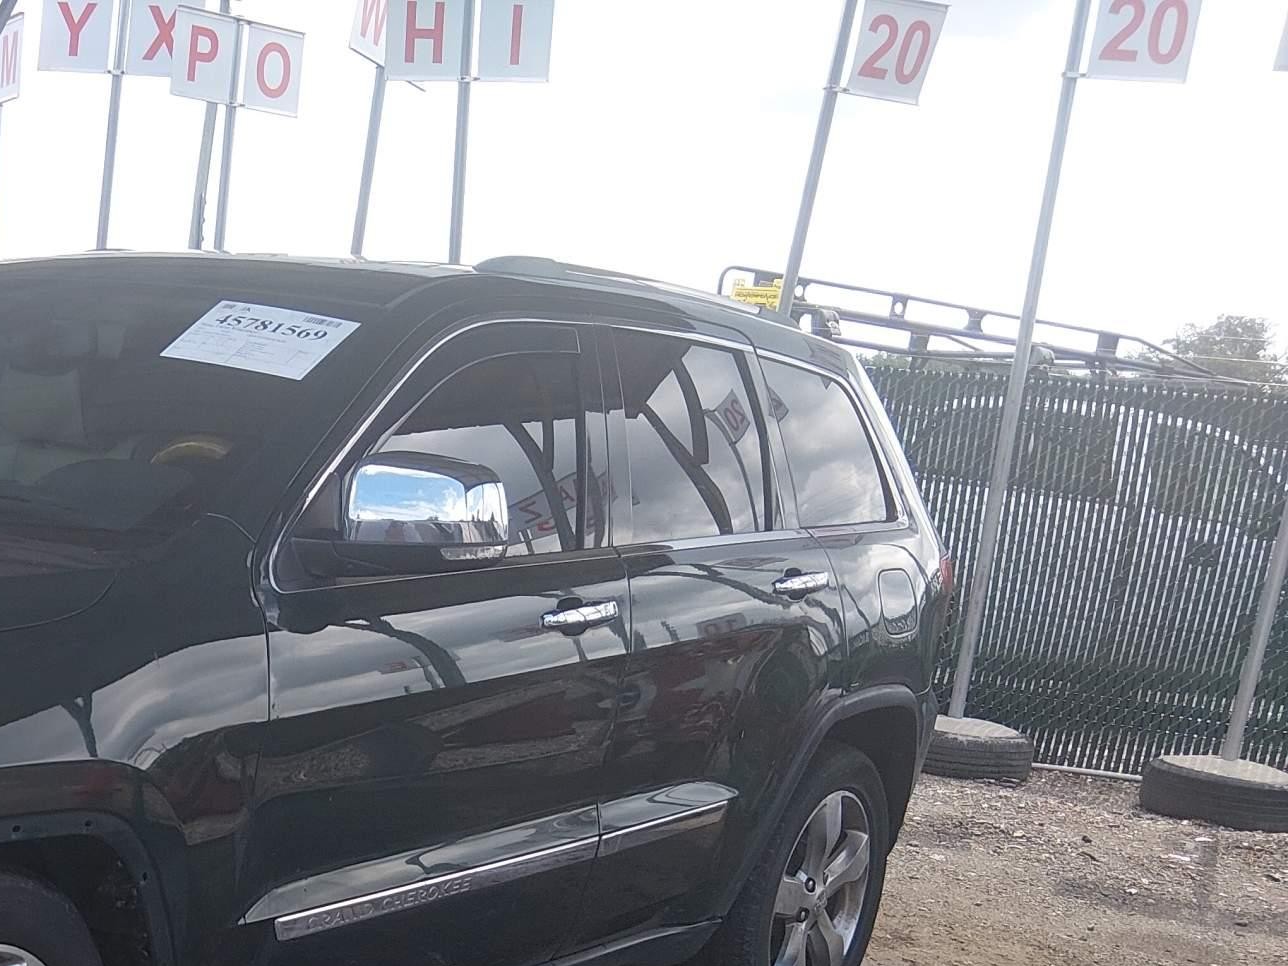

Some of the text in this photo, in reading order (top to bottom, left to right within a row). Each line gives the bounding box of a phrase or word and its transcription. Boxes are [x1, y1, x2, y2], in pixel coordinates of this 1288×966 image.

[57, 1, 177, 61] Y X
[187, 24, 291, 99] P O
[404, 0, 446, 64] H
[857, 13, 932, 86] 20
[1098, 0, 1190, 65] 20
[215, 313, 329, 342] 45781569
[382, 877, 472, 914] CHEROKEE
